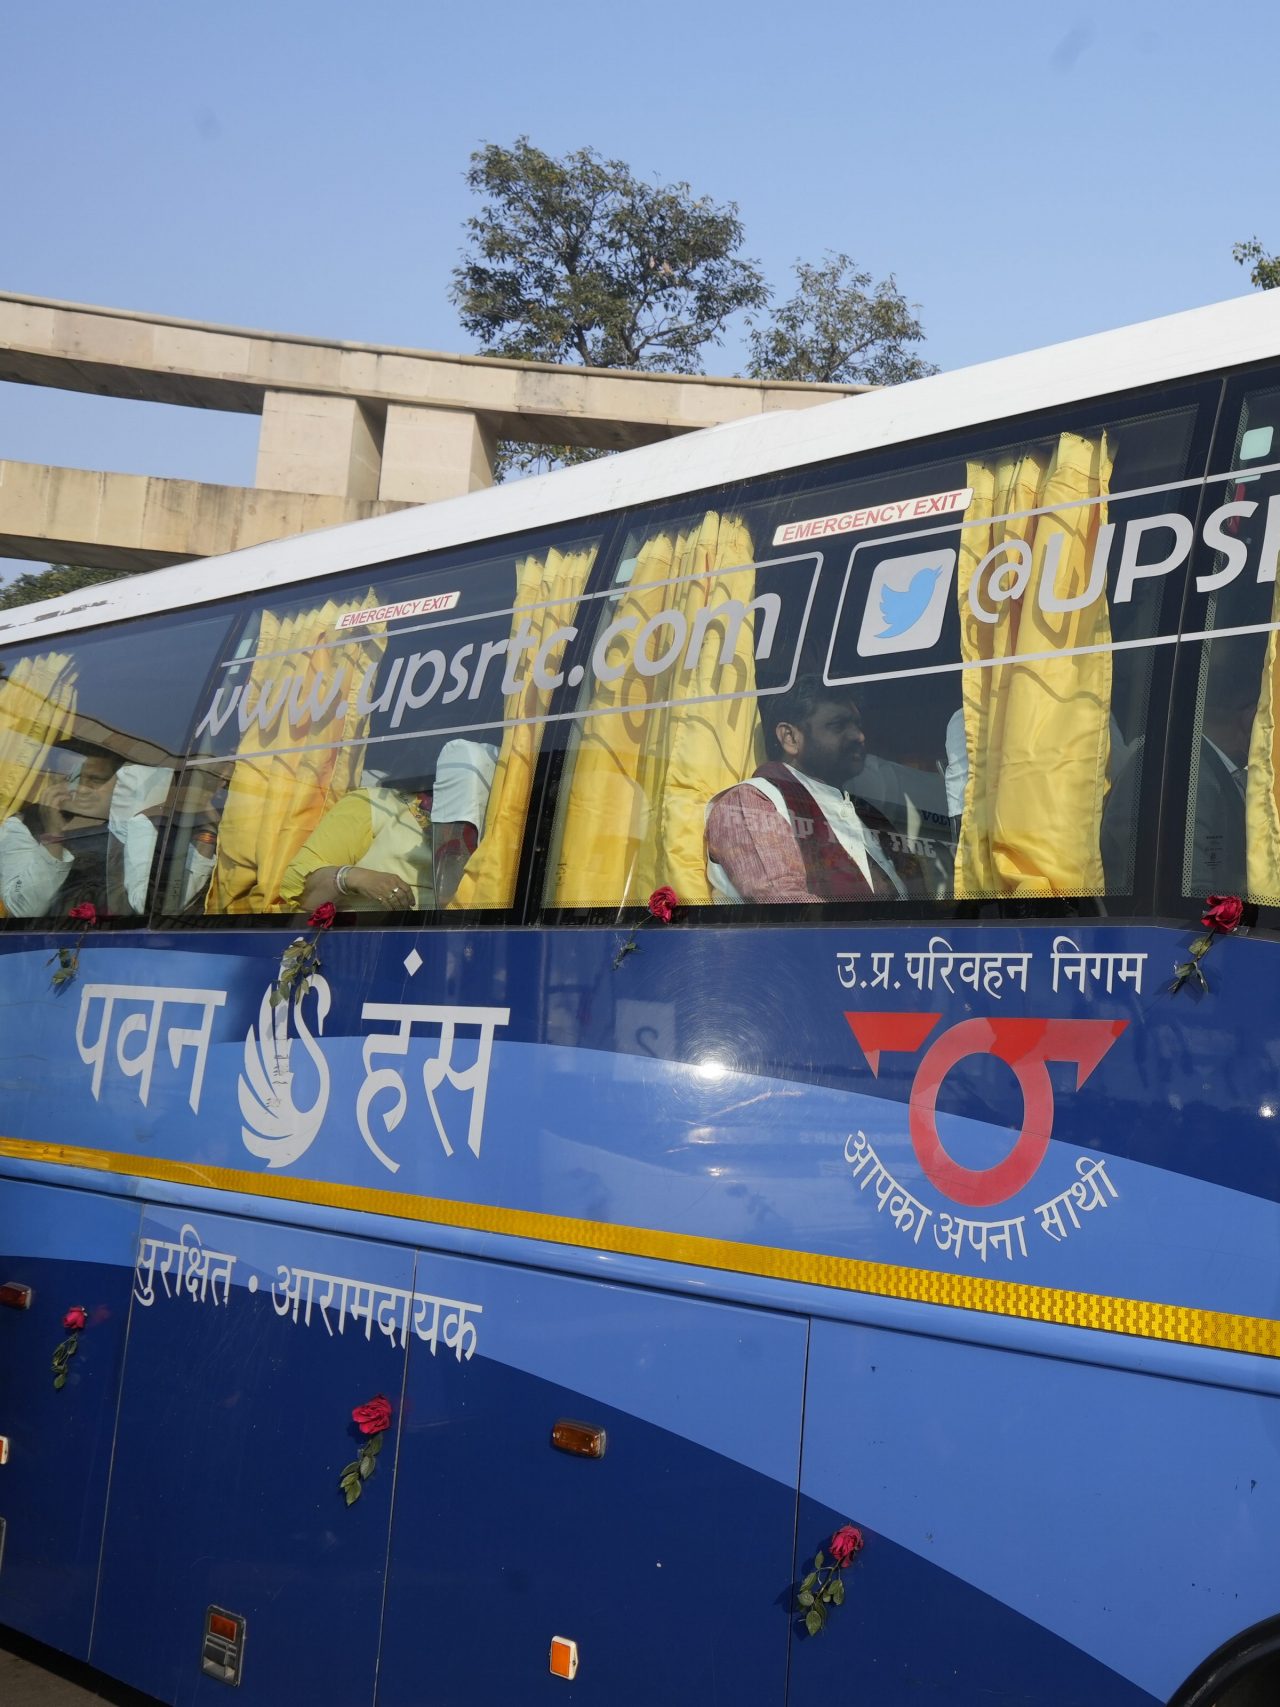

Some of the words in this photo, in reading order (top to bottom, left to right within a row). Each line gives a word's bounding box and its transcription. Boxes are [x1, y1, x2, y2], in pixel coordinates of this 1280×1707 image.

[782, 503, 910, 541] EMERGENCY
[913, 493, 961, 515] EXIT
[195, 592, 781, 738] www.upsrtc.com
[341, 600, 421, 627] EMERGENCY
[421, 595, 452, 611] EXIT
[1050, 935, 1148, 995] निगम
[76, 983, 227, 1116] पवन
[356, 948, 510, 1173] हंस
[844, 1130, 933, 1244] आपका
[933, 1213, 1028, 1263] अपना
[1033, 1156, 1118, 1242] साथी
[133, 1223, 236, 1307] सुरक्षित
[272, 1264, 483, 1364] आरामदायक
